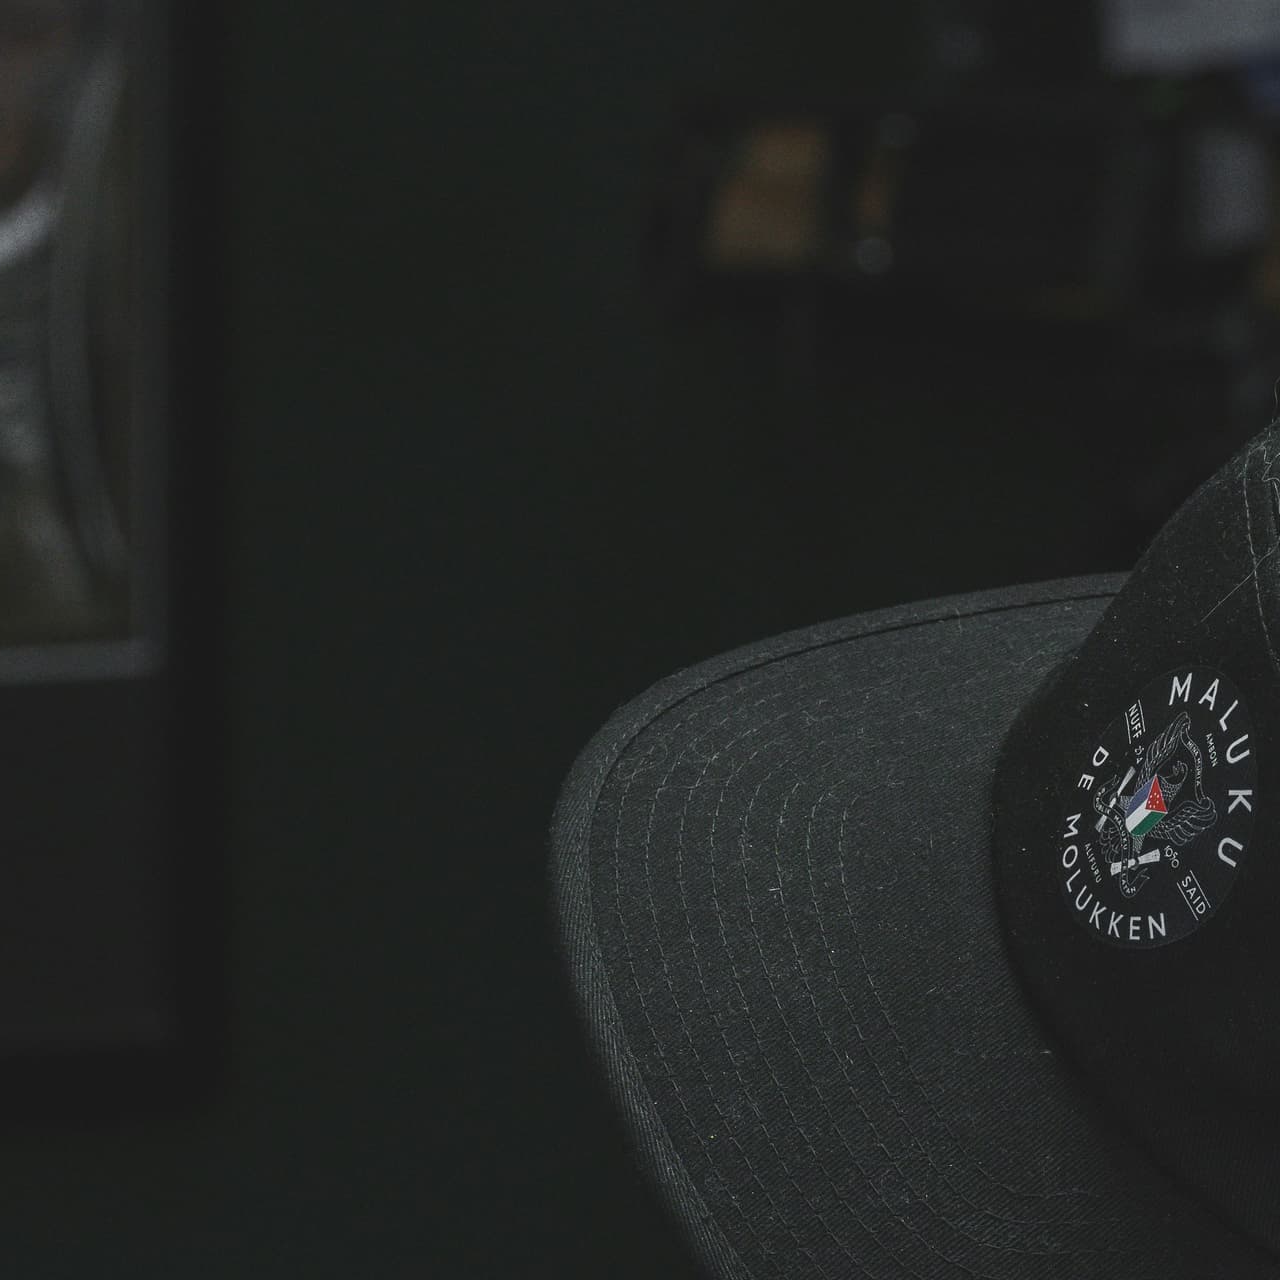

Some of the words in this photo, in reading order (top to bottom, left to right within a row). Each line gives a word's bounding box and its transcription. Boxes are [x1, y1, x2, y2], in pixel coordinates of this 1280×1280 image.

[1128, 703, 1144, 740] NUFF
[1077, 745, 1110, 791] DE
[1168, 672, 1253, 868] MALUKU
[1205, 732, 1219, 768] AMBON
[1062, 813, 1167, 941] MOLUKKEN
[1084, 842, 1102, 884] ALIFURU
[1181, 875, 1207, 915] SAID
